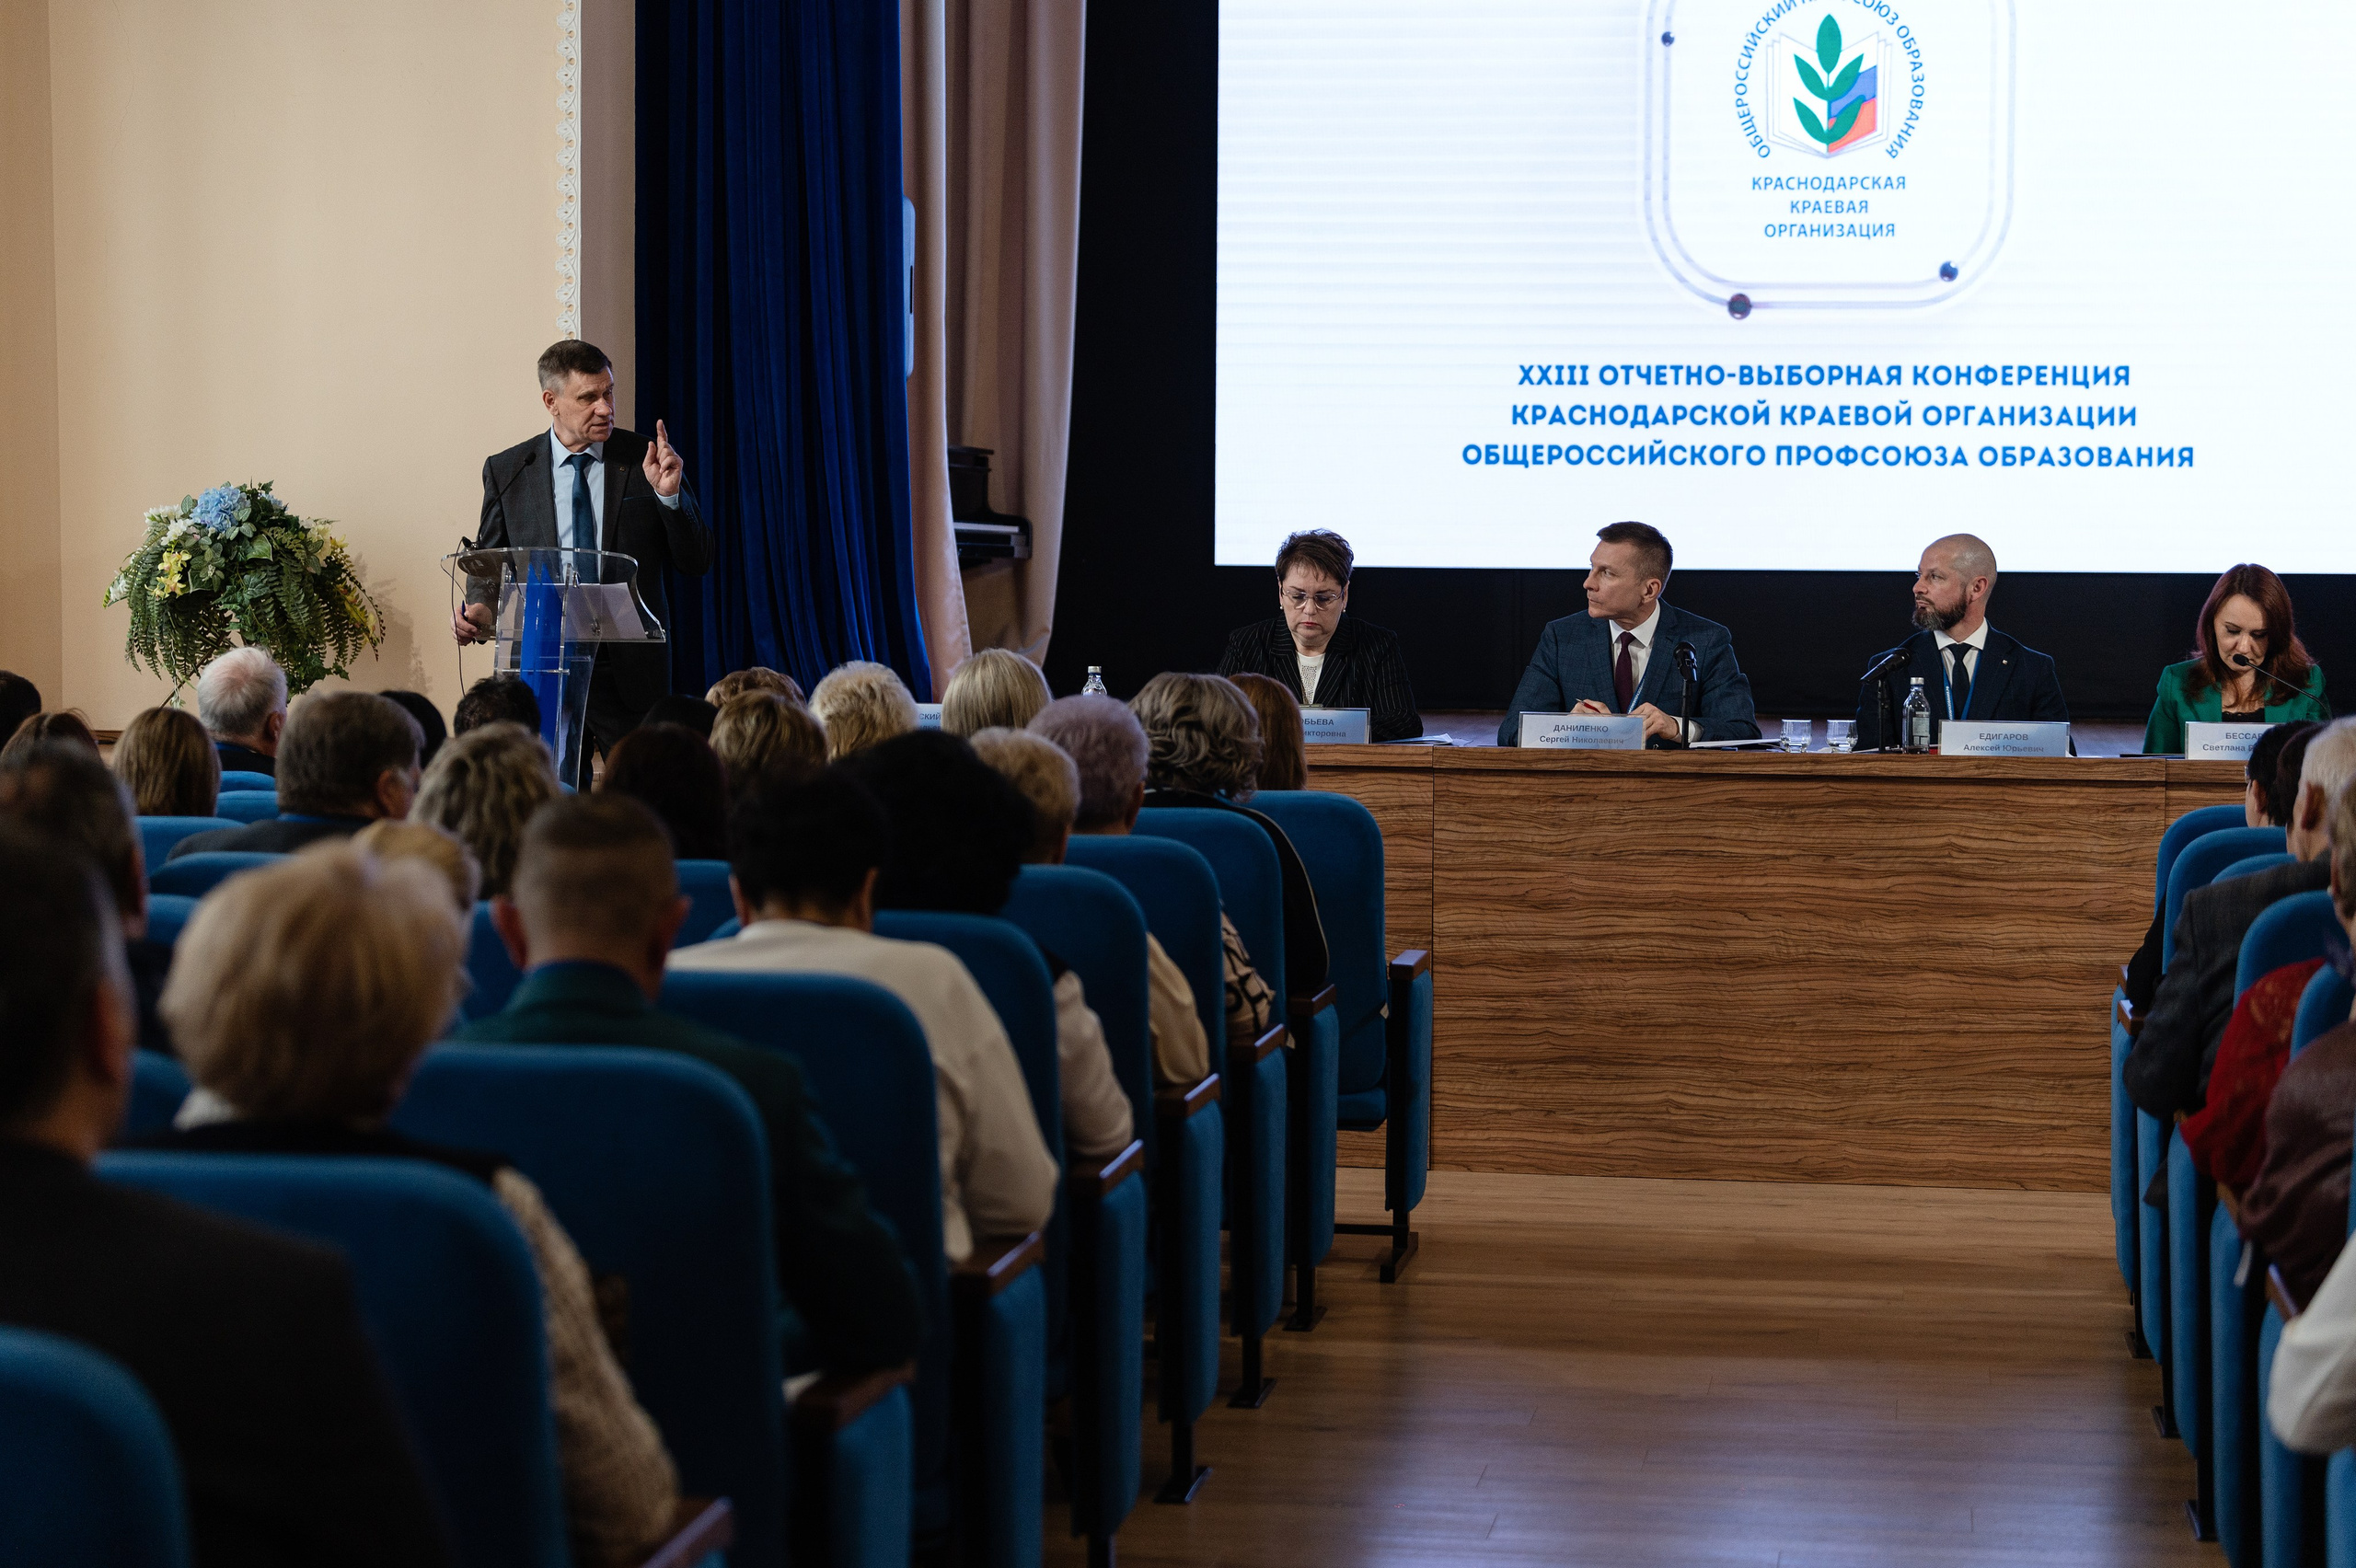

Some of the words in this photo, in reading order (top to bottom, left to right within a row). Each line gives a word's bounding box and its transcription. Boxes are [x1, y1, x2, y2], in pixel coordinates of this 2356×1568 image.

[1885, 25, 1925, 159] ОБРАЗОВАНИЯ
[1752, 176, 1906, 193] КРАСНОДАРСКАЯ
[1790, 200, 1868, 213] КРАЕВАЯ
[1764, 224, 1895, 239] ОРГАНИЗАЦИЯ
[1599, 364, 1902, 386] ОТЧЕТНО-ВЫБОРНАЯ
[1912, 364, 2130, 389] КОНФЕРЕНЦИЯ
[1512, 398, 1770, 429] КРАСНОДАРСКОЙ
[1780, 399, 1911, 426] КРАЕВОЙ
[1922, 405, 2136, 430] ОРГАНИЗАЦИИ
[1461, 439, 1766, 468] ОБЩЕРОССИЙСКОГО
[1775, 444, 1969, 467] ПРОФСОЮЗА
[1978, 445, 2193, 467] ОБРАЗОВАНИЯ
[1553, 724, 1609, 732] ДАНИЛЕНКО
[1540, 735, 1570, 744] Сергей
[1979, 732, 2029, 741] ЕДИГАРОВ
[2003, 744, 2044, 753] Юрьевич
[2202, 744, 2246, 752] Светлана
